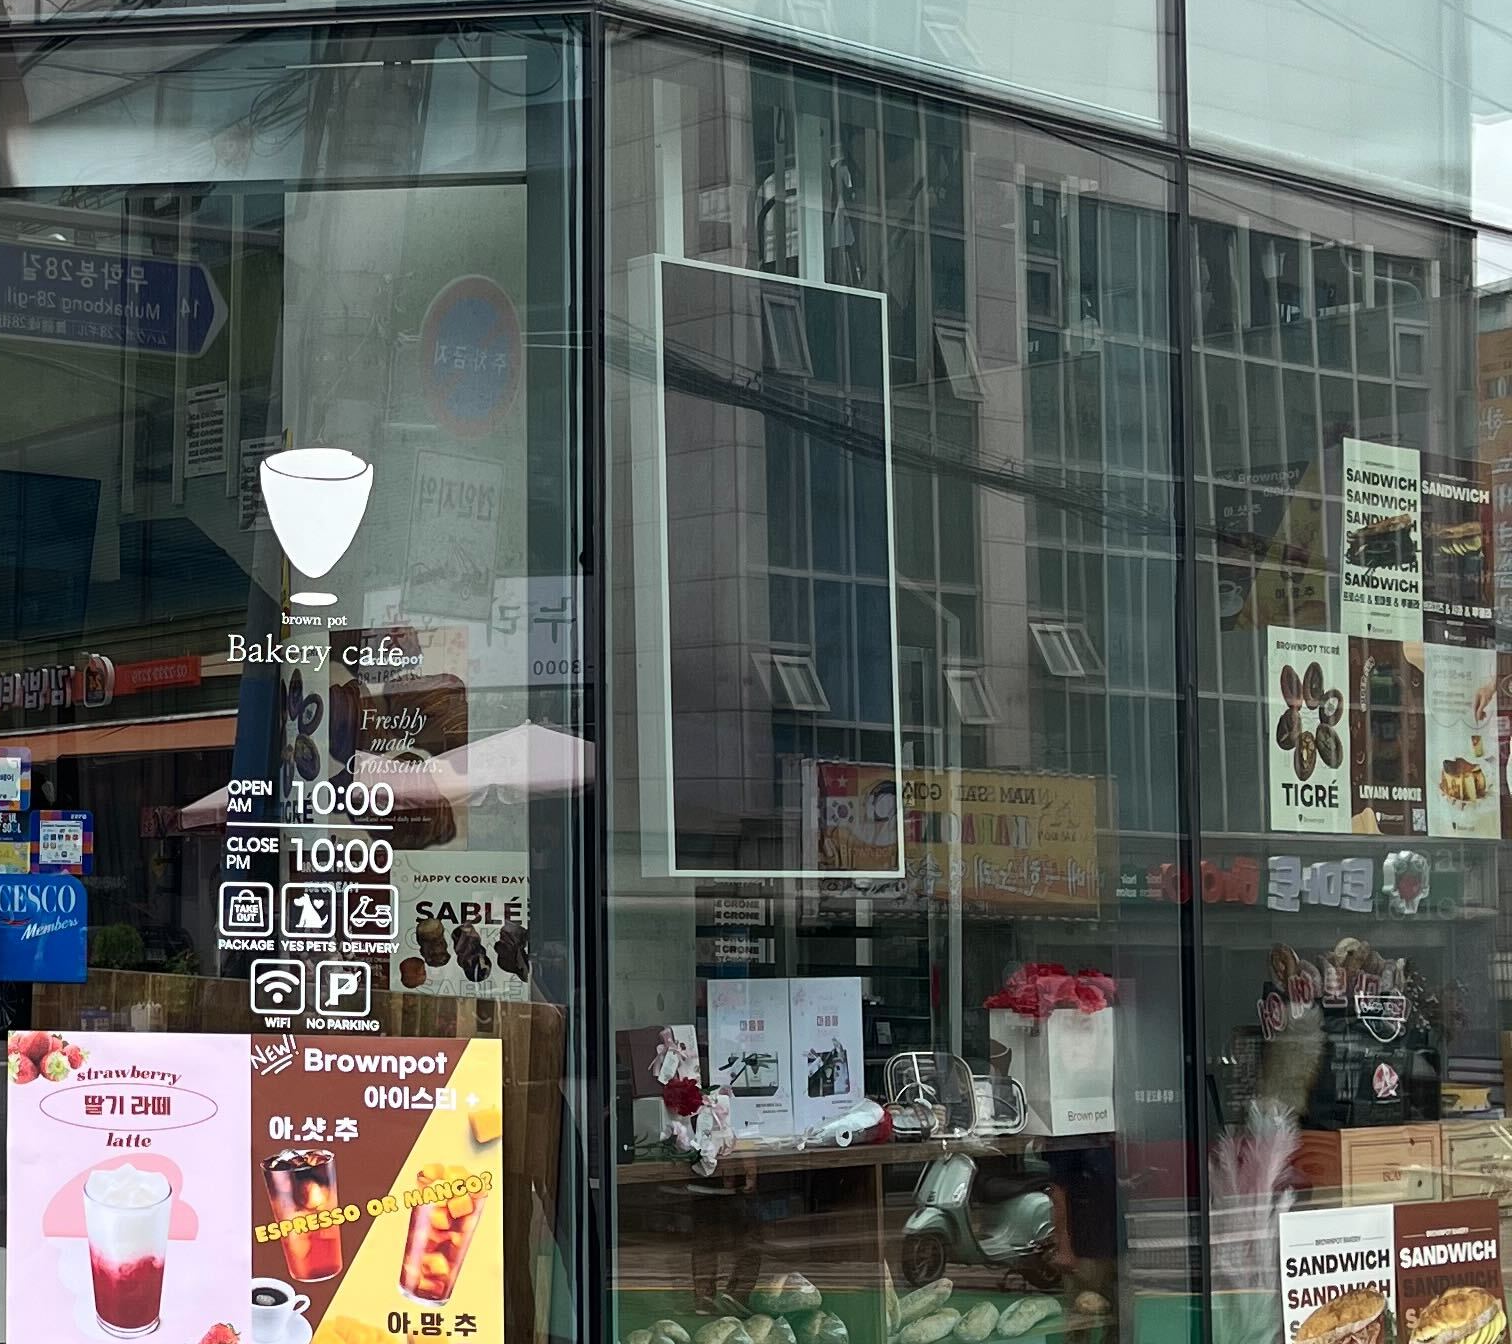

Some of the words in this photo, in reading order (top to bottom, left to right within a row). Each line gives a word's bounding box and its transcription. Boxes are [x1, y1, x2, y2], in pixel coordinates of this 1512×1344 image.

[1345, 466, 1418, 493] SANDWICH
[1346, 488, 1418, 513] SANDWICH
[1422, 480, 1489, 504] SANDWICH
[1344, 571, 1419, 595] SANDWICH
[282, 613, 322, 626] brown
[327, 614, 347, 628] pot
[227, 634, 332, 671] Bakery
[342, 636, 403, 666] cafe
[360, 708, 428, 734] Freshly
[370, 730, 416, 752] made
[227, 780, 272, 797] OPEN
[291, 780, 394, 817] 10:00
[1282, 779, 1339, 809] TIGRÉ
[1359, 783, 1389, 801] LEVAIN
[227, 797, 252, 813] AM
[226, 854, 251, 870] PM
[227, 837, 279, 853] CLOSE
[290, 837, 394, 874] 10:00
[414, 875, 451, 883] HAPPY
[455, 875, 498, 884] COOKIE
[501, 876, 525, 884] DAY
[234, 903, 259, 914] TAKE
[237, 912, 257, 923] OUT
[20, 917, 78, 941] Members
[218, 940, 274, 952] PACKAGE
[281, 940, 304, 952] YES
[306, 941, 336, 953] PETS
[342, 941, 399, 954] DELIVERY
[306, 1018, 325, 1030] NO
[327, 1019, 379, 1032] PARKING
[250, 1034, 300, 1069] NEW!
[304, 1048, 448, 1079] Brownpot
[76, 1064, 182, 1086] strawberry
[84, 1094, 125, 1116] 딸기
[131, 1095, 171, 1117] 라떼
[364, 1086, 457, 1112] 아이스티
[1067, 1109, 1093, 1123] Brown
[1095, 1109, 1108, 1125] pot
[105, 1132, 152, 1148] latte
[269, 1116, 359, 1143] 아.샷.추
[254, 1203, 361, 1244] ESPRESSO
[366, 1195, 398, 1218] OR
[403, 1171, 494, 1209] MANGO?
[1286, 1249, 1390, 1278] SANDWICH
[1399, 1239, 1497, 1269] SANDWICH
[387, 1311, 478, 1337] 아.망.추
